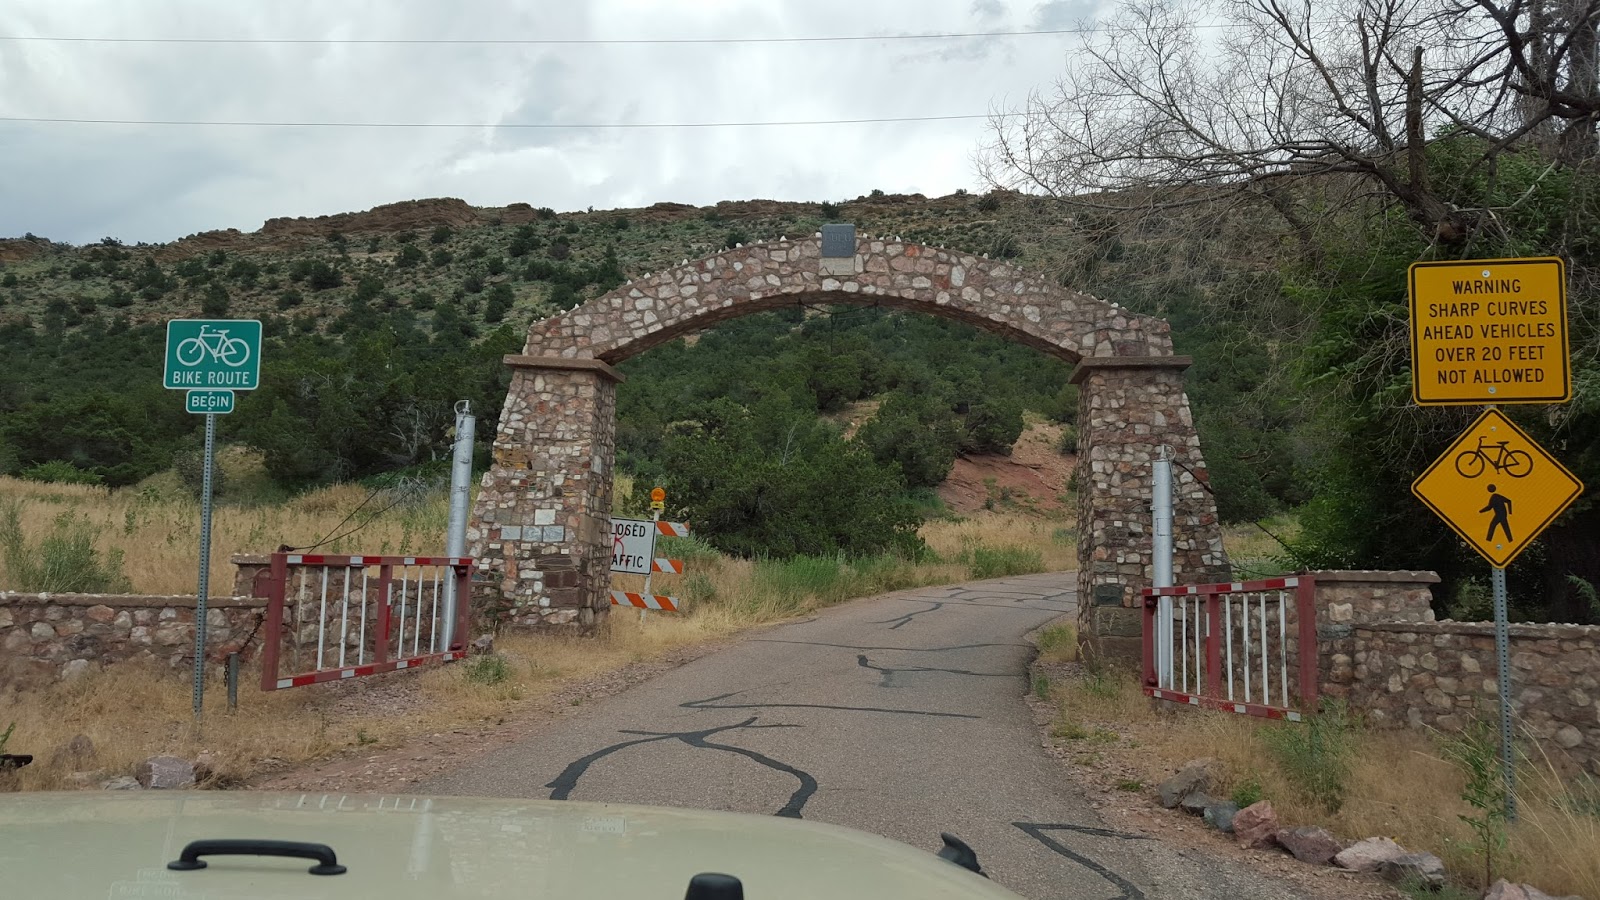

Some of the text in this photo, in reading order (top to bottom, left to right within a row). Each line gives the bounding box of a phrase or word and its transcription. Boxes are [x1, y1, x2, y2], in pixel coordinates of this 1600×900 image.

[1452, 279, 1521, 295] WARNING
[1429, 300, 1548, 318] SHARP CURVES
[1423, 323, 1555, 340] AHEAD VEHICLES
[1435, 345, 1545, 362] OVER 20 FEET
[172, 371, 250, 385] BIKE ROUTE
[1437, 368, 1545, 384] NOT ALLOWED
[191, 395, 229, 407] BEGIN
[611, 523, 646, 538] OSED
[611, 553, 644, 569] AFFIC
